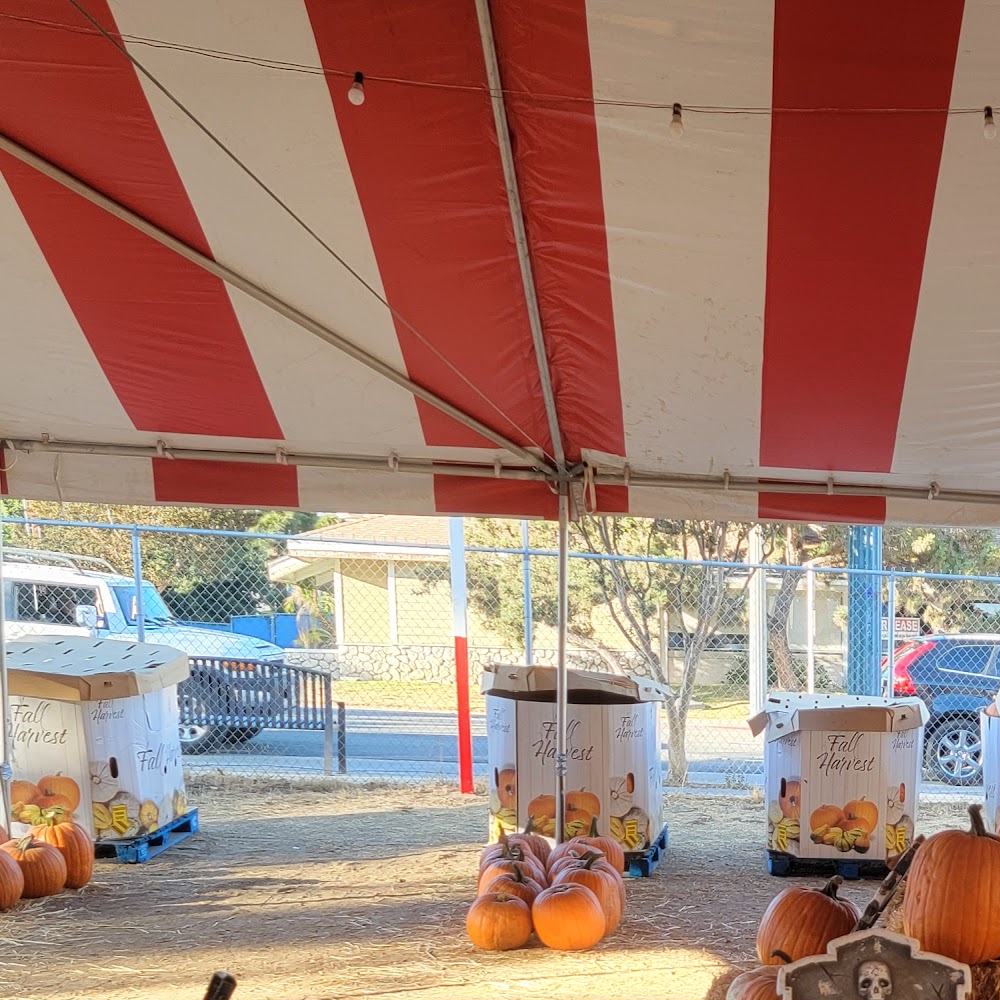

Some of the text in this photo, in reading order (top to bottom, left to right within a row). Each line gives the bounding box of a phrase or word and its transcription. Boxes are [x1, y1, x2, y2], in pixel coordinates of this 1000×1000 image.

[894, 619, 918, 631] EASE
[11, 700, 51, 724] Fall
[91, 709, 124, 725] Harvest
[620, 714, 638, 728] Fall
[7, 719, 68, 749] Harvest
[614, 727, 644, 742] Harvest
[827, 732, 864, 753] Fall
[137, 743, 165, 771] Fall
[532, 739, 595, 765] Havest
[816, 752, 875, 776] Harvest
